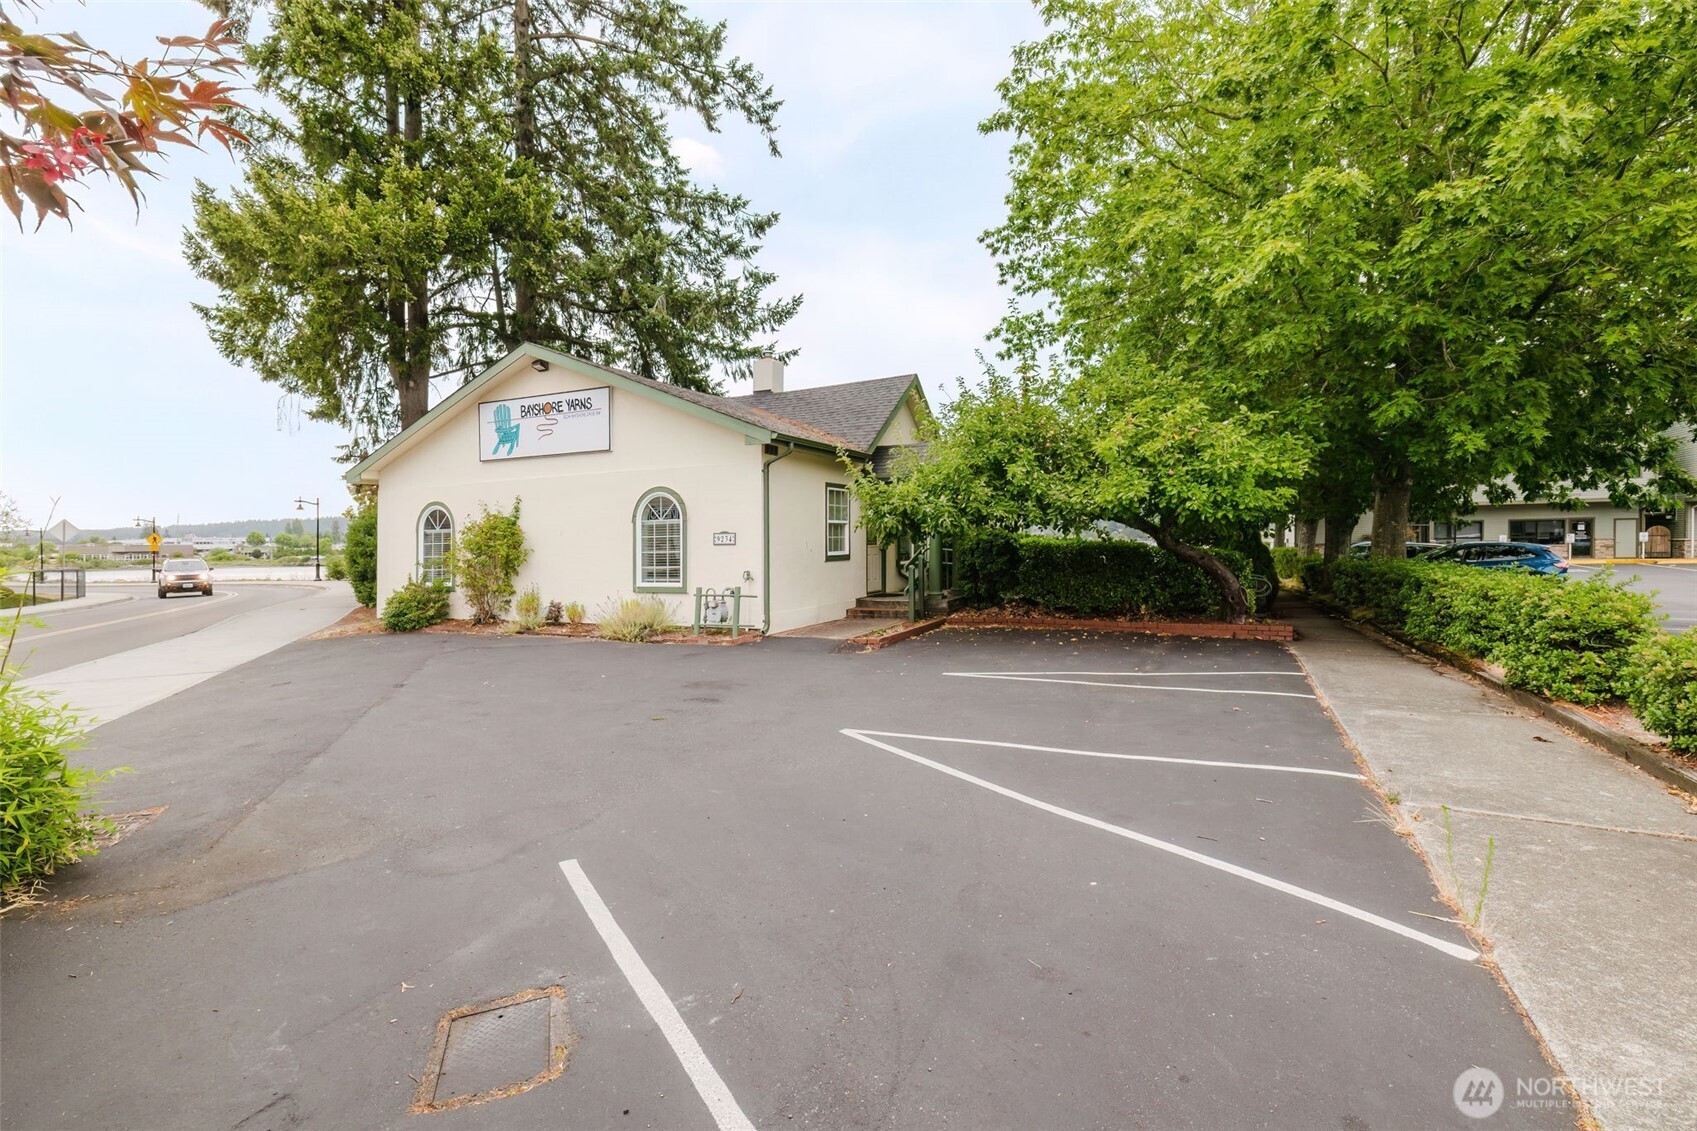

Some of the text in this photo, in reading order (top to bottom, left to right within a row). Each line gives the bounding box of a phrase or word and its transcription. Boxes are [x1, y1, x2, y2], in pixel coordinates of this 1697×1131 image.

[521, 401, 564, 418] BAYSHORE
[565, 397, 593, 411] YARNS
[716, 535, 732, 543] 9234
